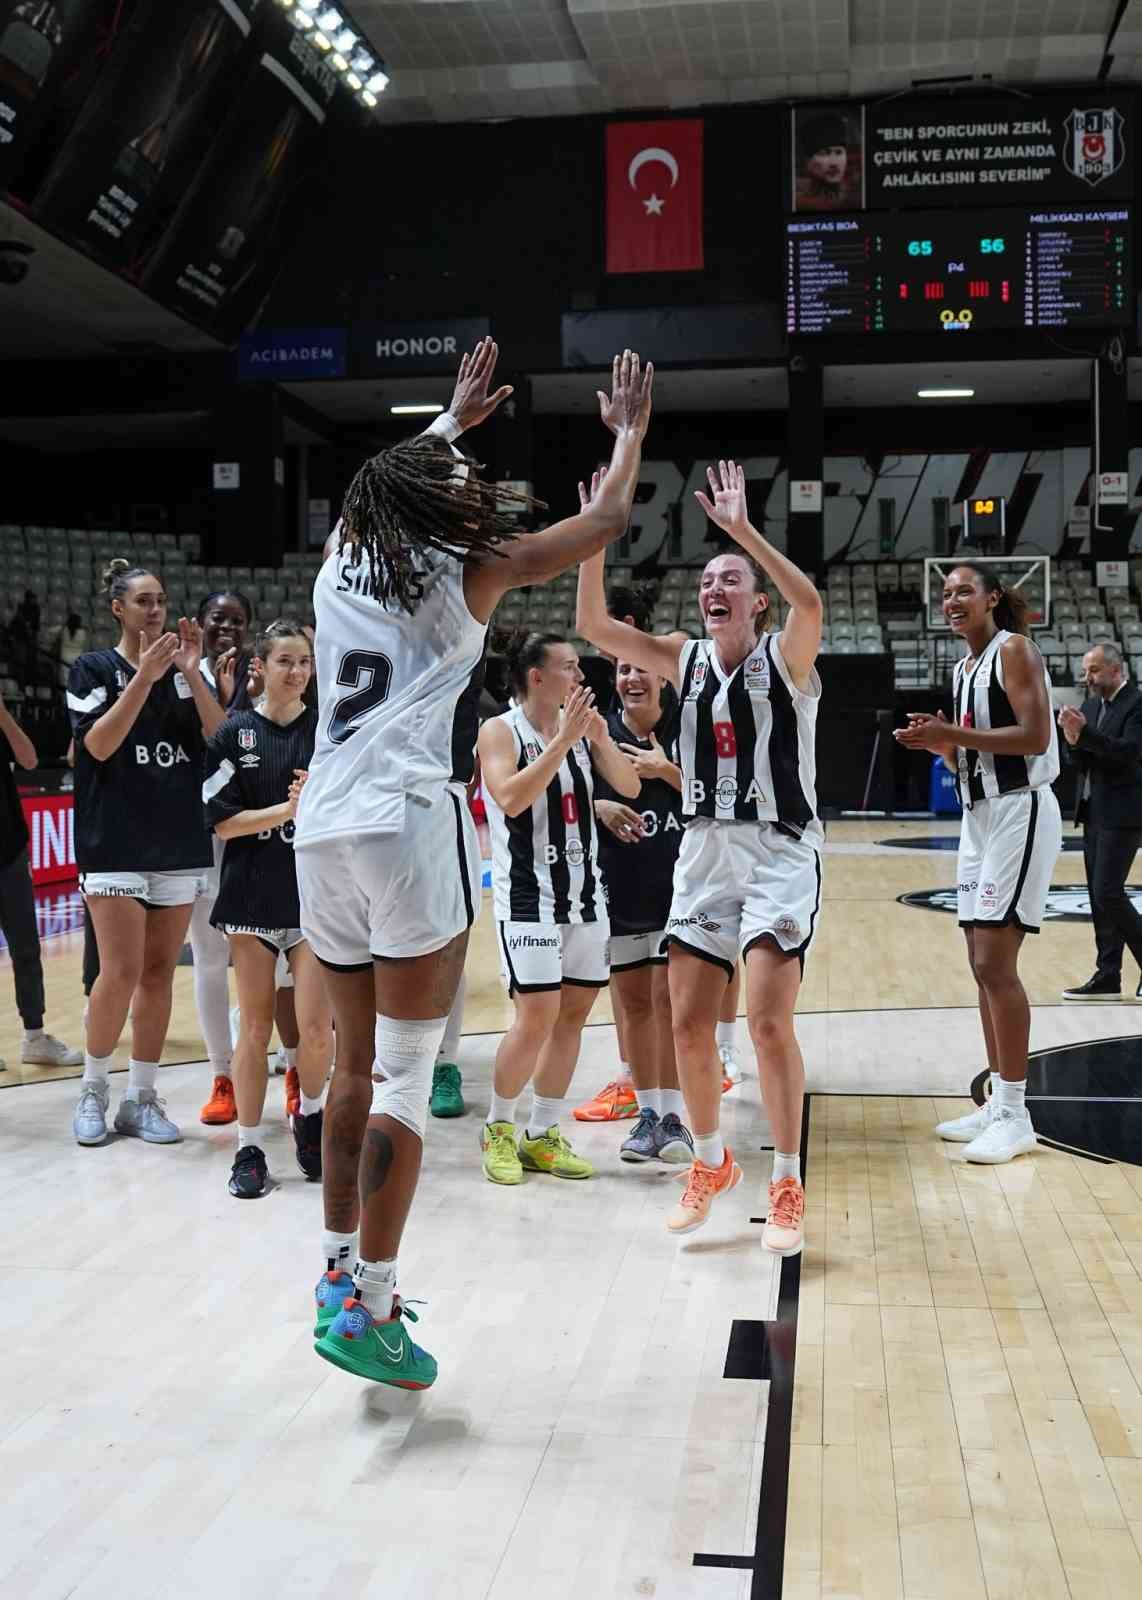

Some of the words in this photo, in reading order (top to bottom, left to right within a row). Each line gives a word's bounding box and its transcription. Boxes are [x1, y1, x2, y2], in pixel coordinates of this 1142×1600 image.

[917, 122, 1009, 139] SPORCUNUN
[1012, 117, 1052, 136] ZEKİ,
[873, 149, 919, 167] ÇEVİK
[922, 149, 942, 163] VE
[945, 147, 980, 161] AYNI
[983, 144, 1057, 160] ZAMANDA
[978, 165, 1052, 183] SEVERİM"
[907, 240, 933, 256] 65
[979, 238, 1005, 254] 56
[250, 346, 334, 363] ACIBADEM
[375, 336, 458, 358] HONOR
[327, 648, 393, 745] 2
[713, 721, 737, 758] 8
[135, 741, 191, 768] BOA
[689, 775, 768, 810] BOA
